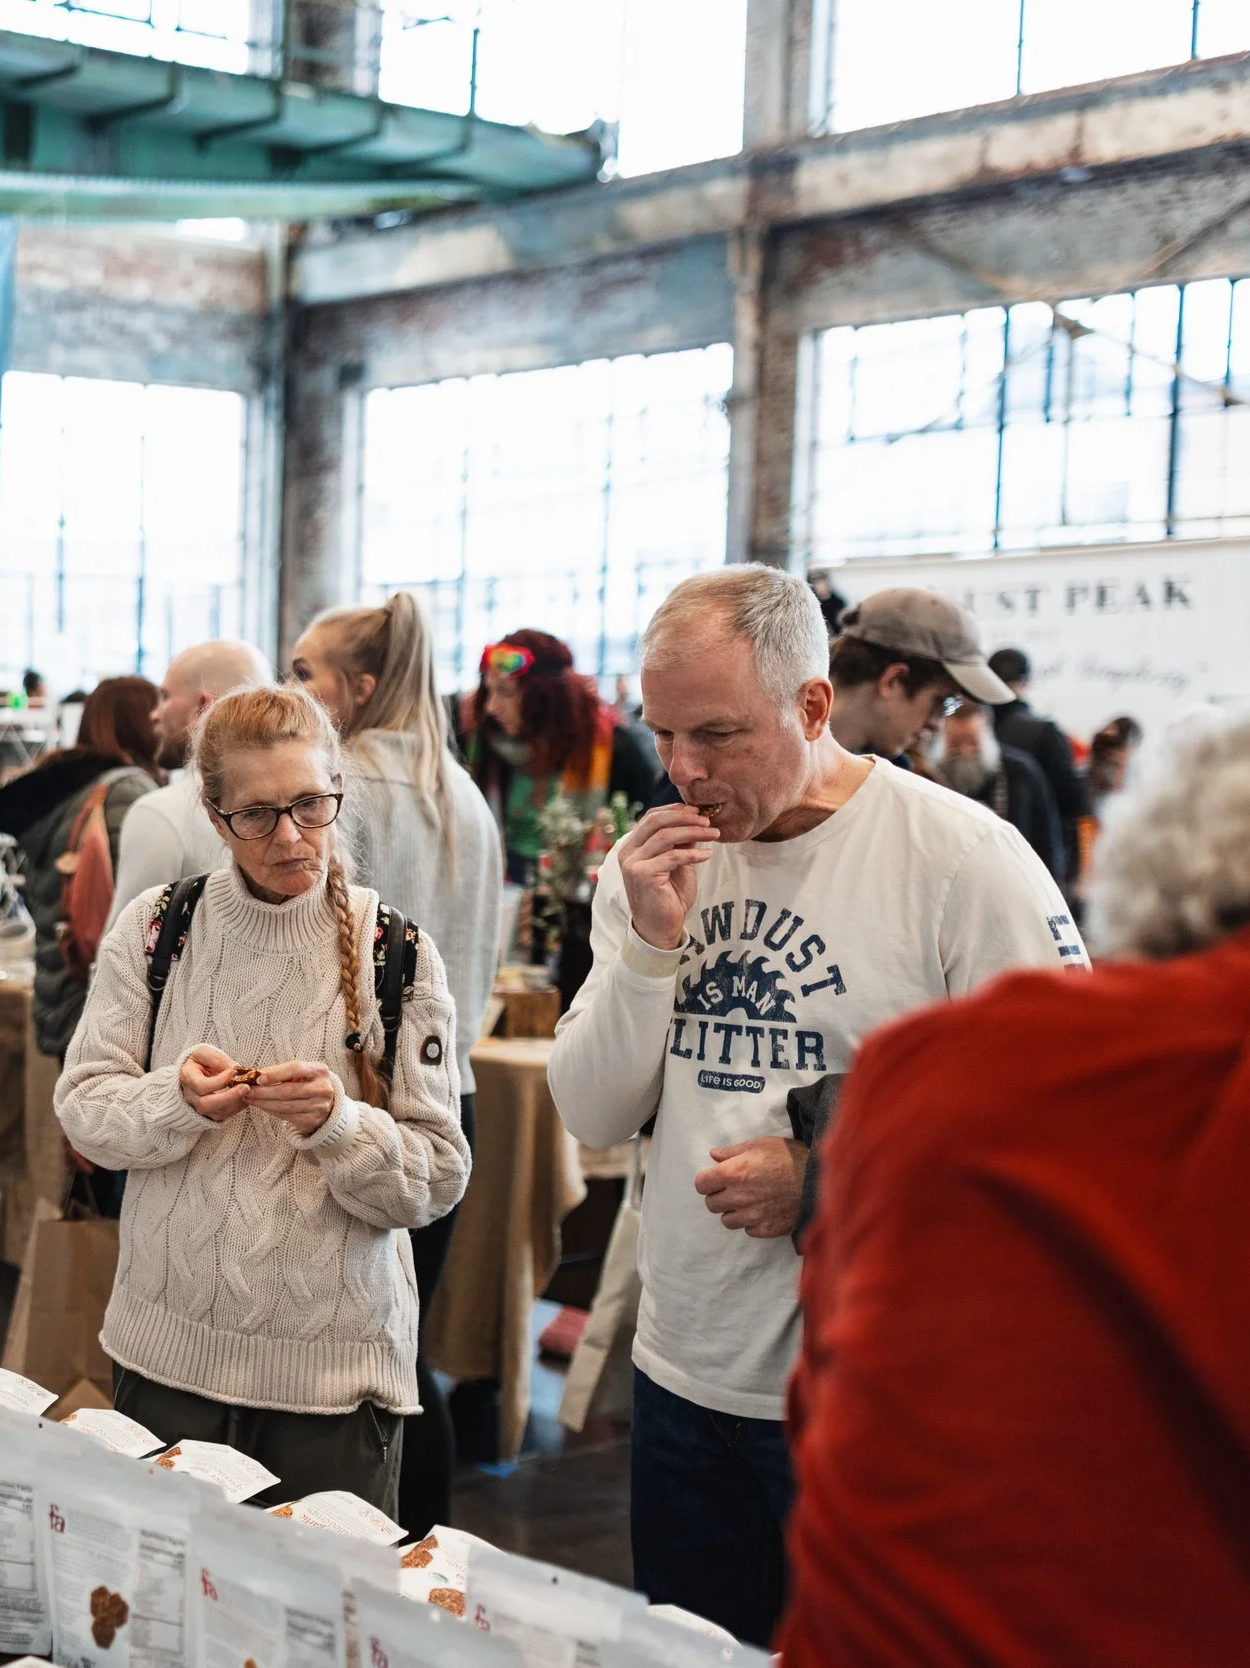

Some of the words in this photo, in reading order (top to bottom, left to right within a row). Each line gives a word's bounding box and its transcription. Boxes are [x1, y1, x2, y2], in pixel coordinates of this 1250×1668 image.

[962, 585, 1050, 617] UST
[1063, 573, 1196, 617] PEAK
[696, 981, 724, 1011] IS
[732, 975, 777, 1016] MAN
[669, 1017, 827, 1072] LITTER
[722, 1077, 732, 1087] IS
[734, 1078, 761, 1090] GOOD
